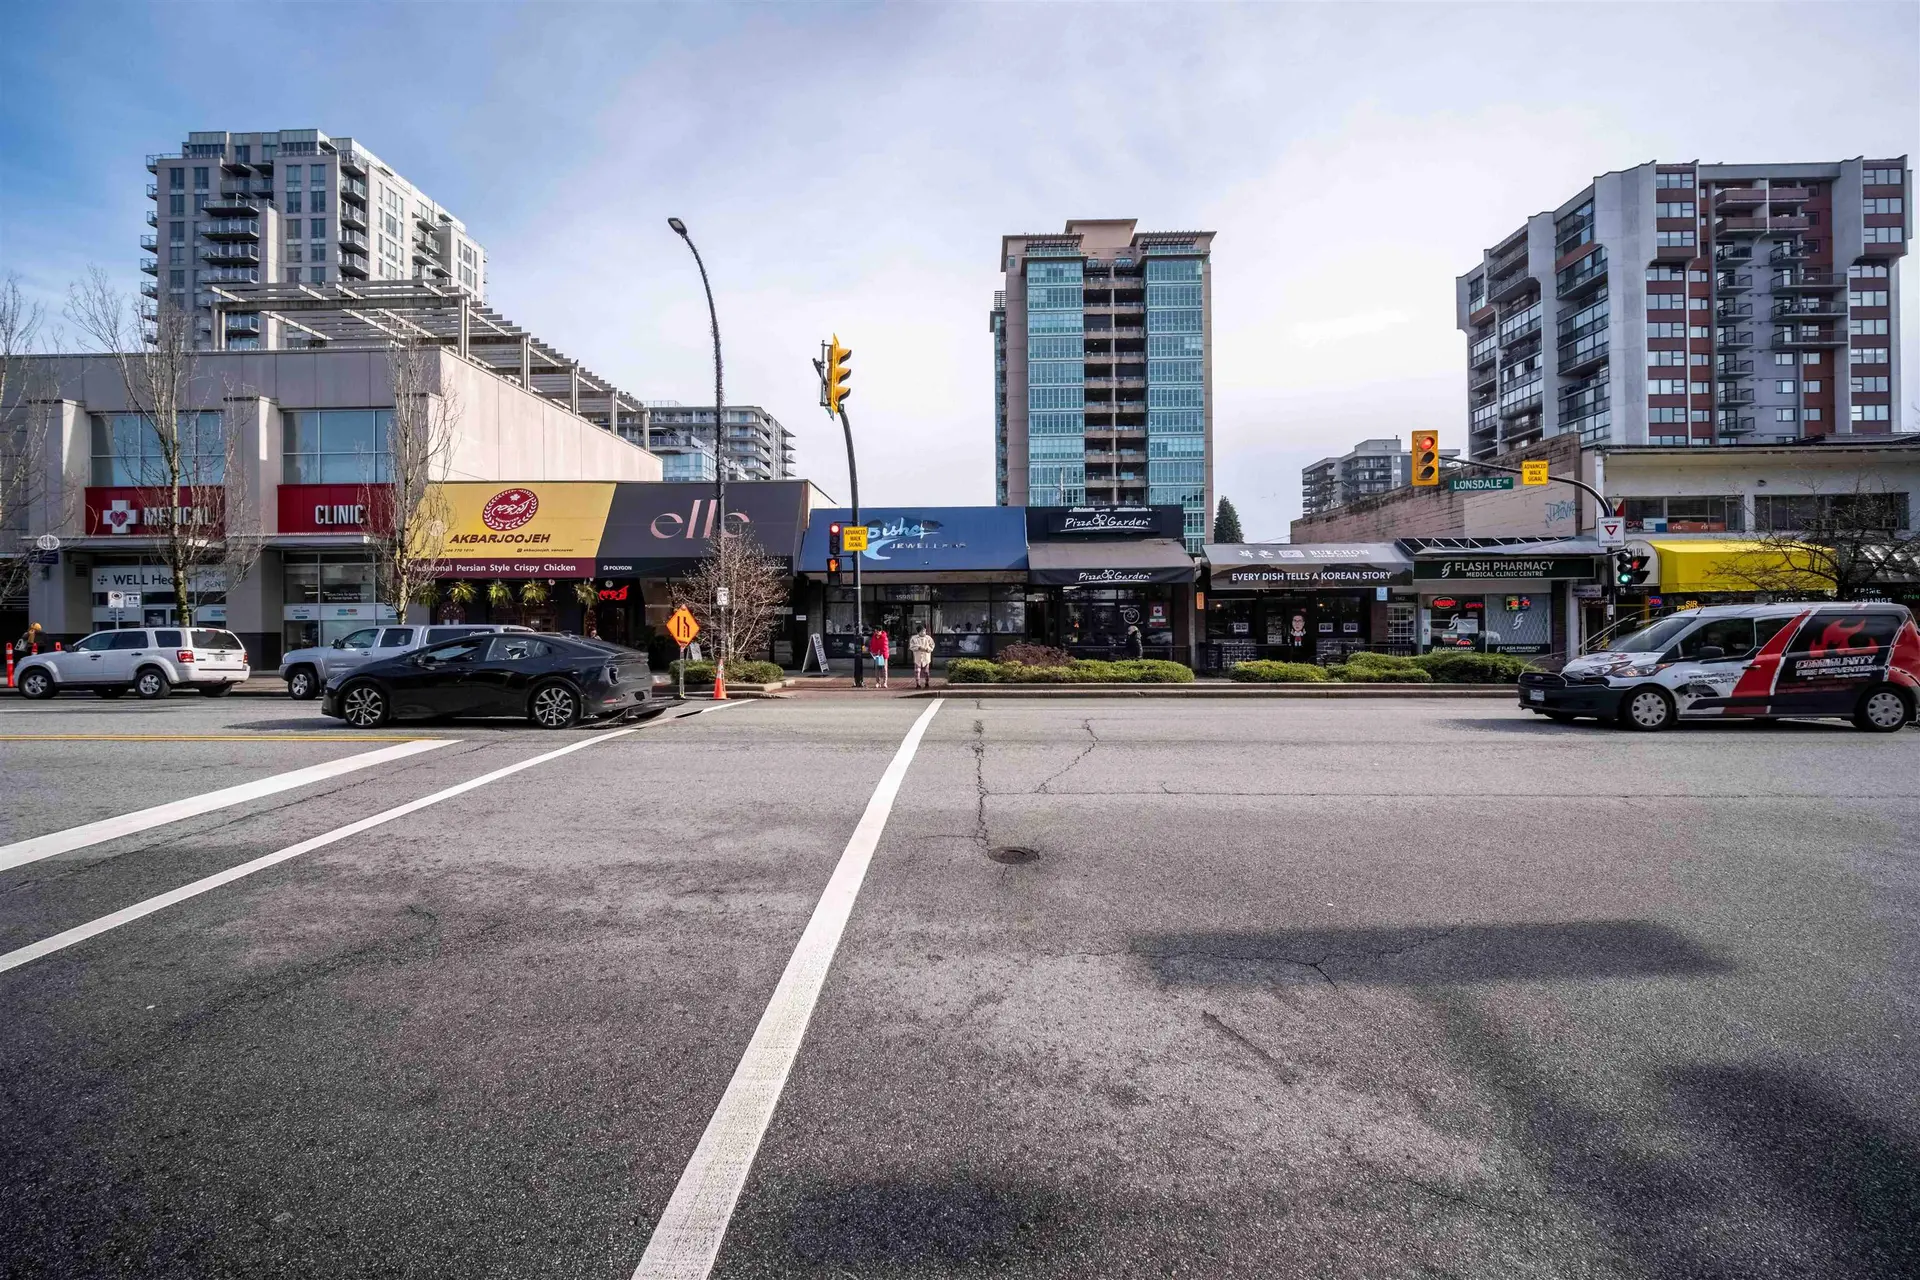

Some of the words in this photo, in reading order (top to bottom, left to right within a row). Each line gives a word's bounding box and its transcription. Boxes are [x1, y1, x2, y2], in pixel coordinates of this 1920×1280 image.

[1454, 479, 1502, 490] LONSDALE
[143, 506, 212, 526] MEICAL
[315, 505, 365, 525] CLINIC
[1065, 517, 1093, 528] Pizza
[1107, 516, 1149, 526] Garden
[449, 534, 551, 544] AKBARJOOJEH
[456, 564, 486, 572] Persian
[489, 564, 510, 573] Style
[514, 563, 540, 574] Crispy
[543, 563, 577, 572] Chicken
[1455, 562, 1490, 571] FLASH
[1493, 561, 1554, 571] PHARMACY
[113, 574, 149, 585] WELL
[1078, 572, 1103, 581] Pizza
[1114, 571, 1150, 580] Garden
[1231, 573, 1259, 581] EVERY
[1262, 573, 1285, 581] DISH
[1286, 572, 1310, 581] TELLS
[1320, 572, 1360, 580] KOREAN
[1362, 571, 1392, 580] STORY
[1795, 655, 1876, 669] COMMUNITY
[1796, 669, 1818, 677] FIRE
[1818, 664, 1878, 675] PREVENTION
